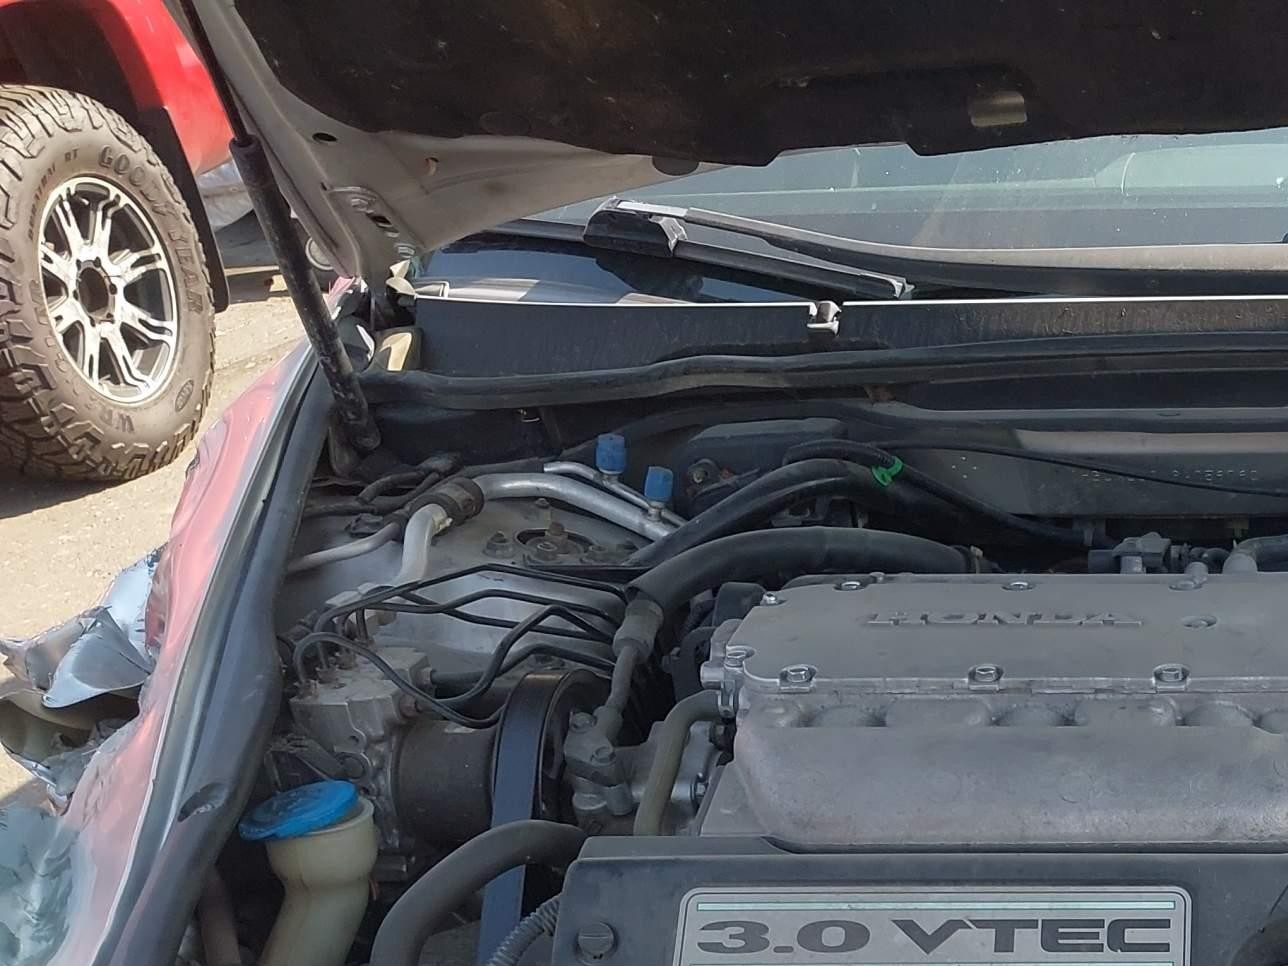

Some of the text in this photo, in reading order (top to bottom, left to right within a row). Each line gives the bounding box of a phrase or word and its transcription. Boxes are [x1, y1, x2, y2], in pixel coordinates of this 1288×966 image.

[864, 611, 1144, 627] HONDA
[696, 918, 1171, 955] 3.0 VTEC
